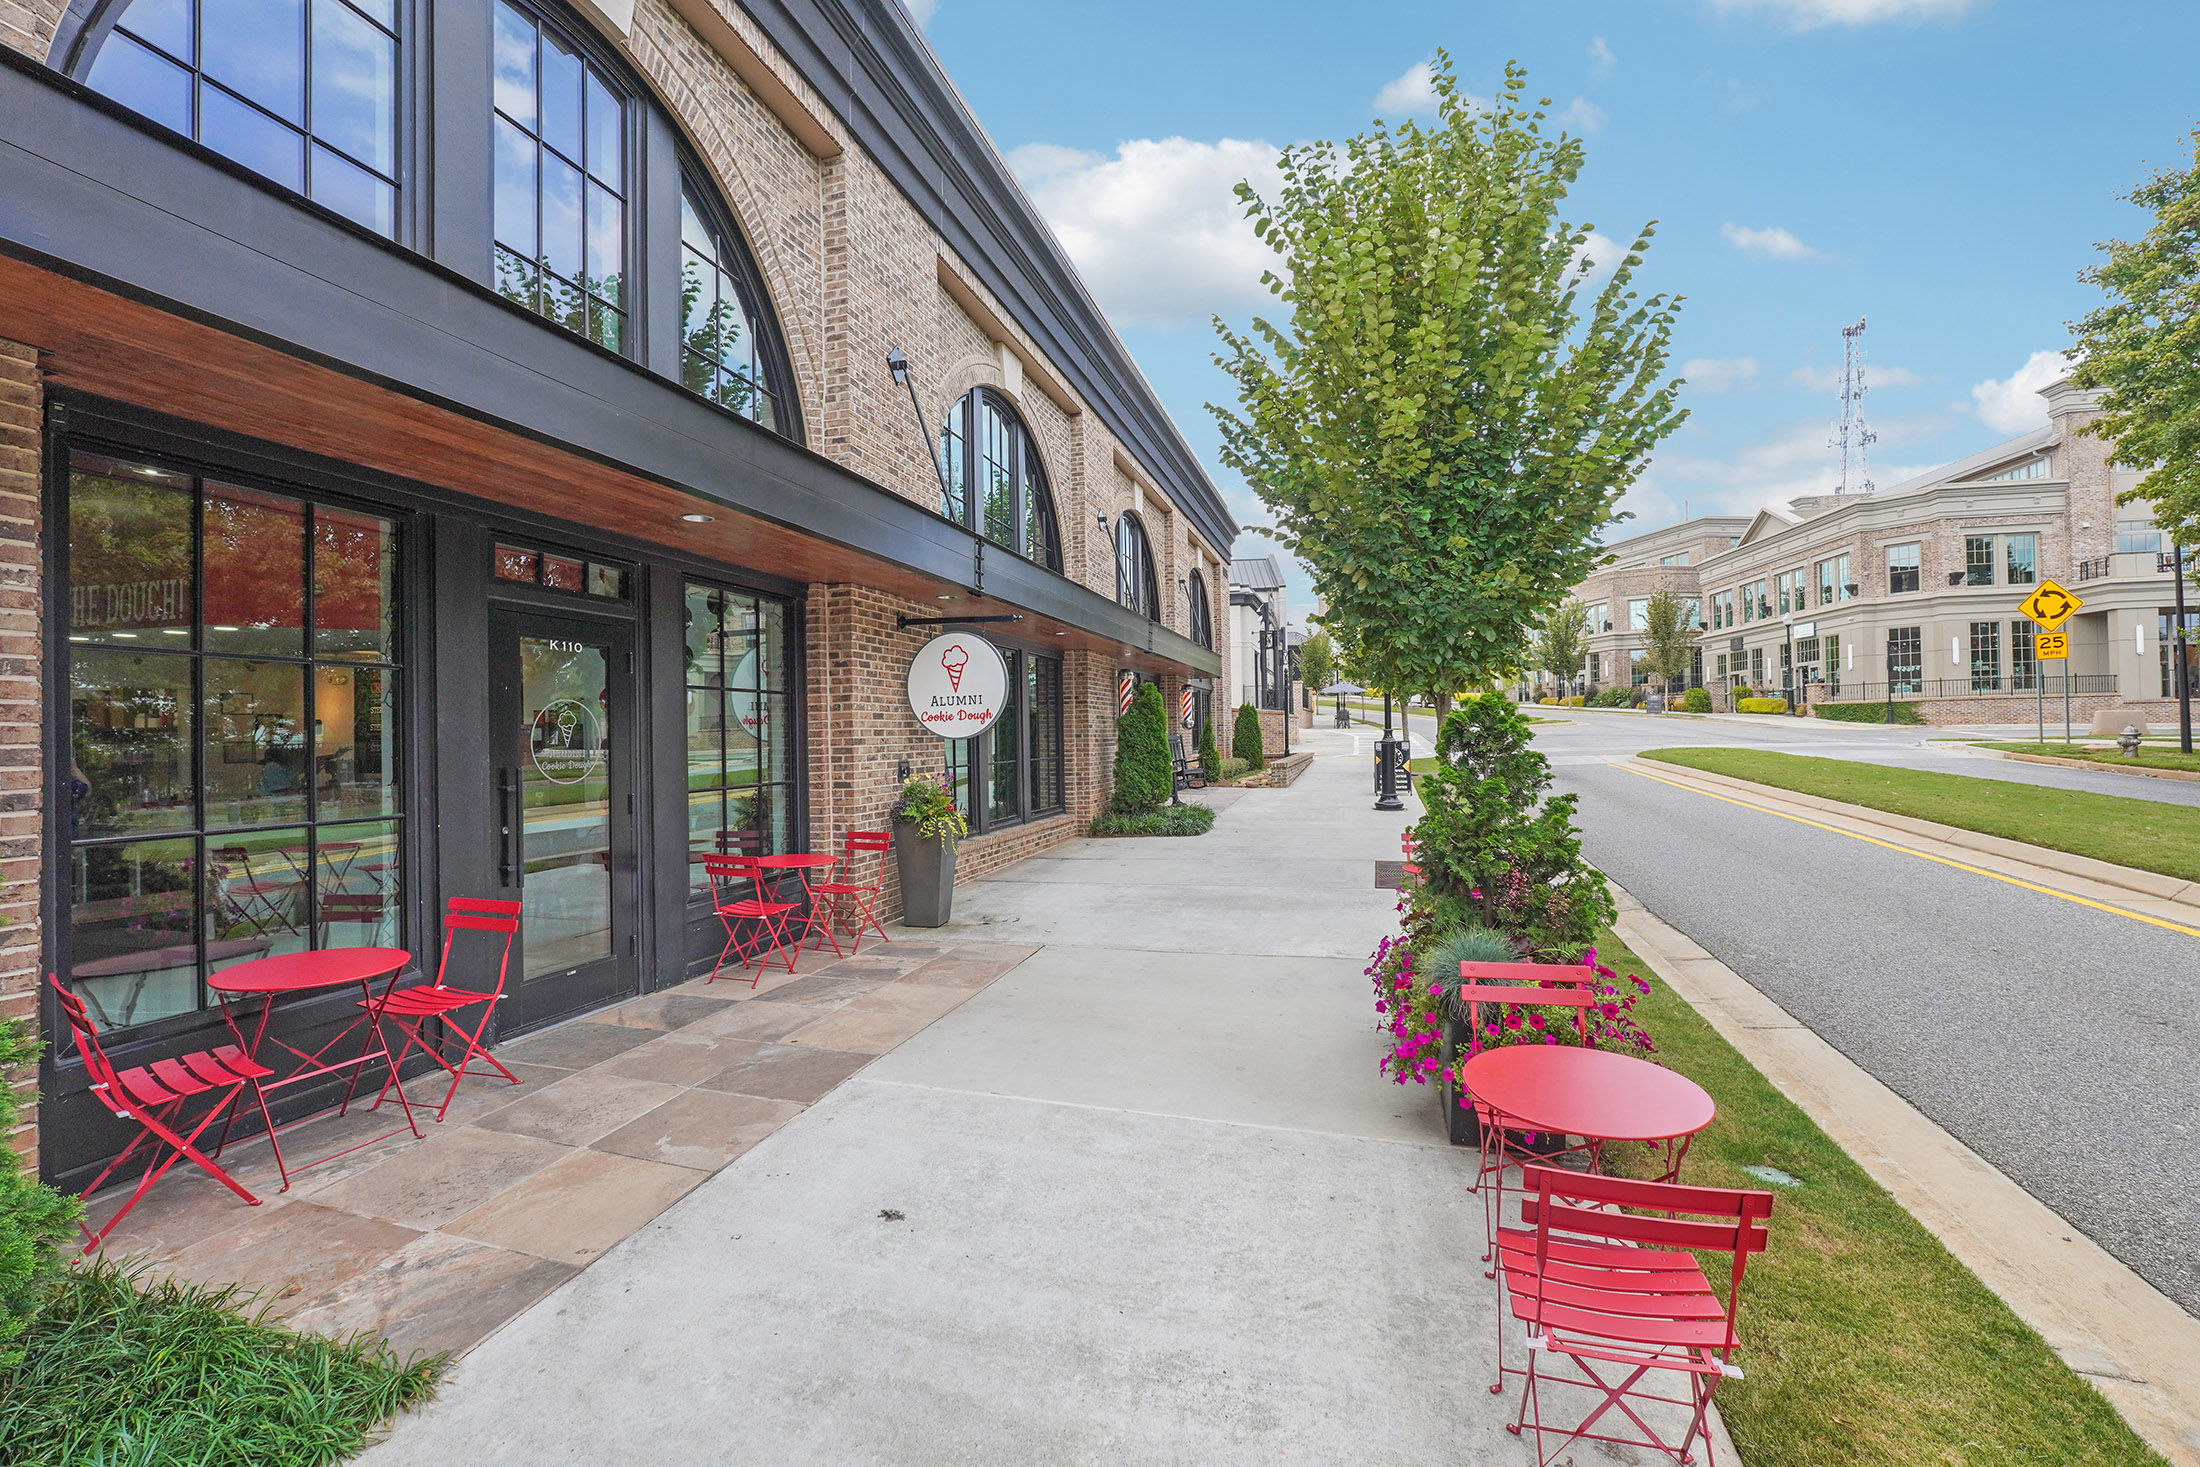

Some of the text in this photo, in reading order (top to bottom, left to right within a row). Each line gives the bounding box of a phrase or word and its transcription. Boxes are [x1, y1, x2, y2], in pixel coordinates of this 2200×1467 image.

[70, 579, 184, 627] HE DOUGH!
[2039, 636, 2064, 649] 25
[930, 694, 983, 707] ALUMNI
[920, 707, 993, 725] Cookie Dough
[541, 759, 592, 773] Cookie Dough
